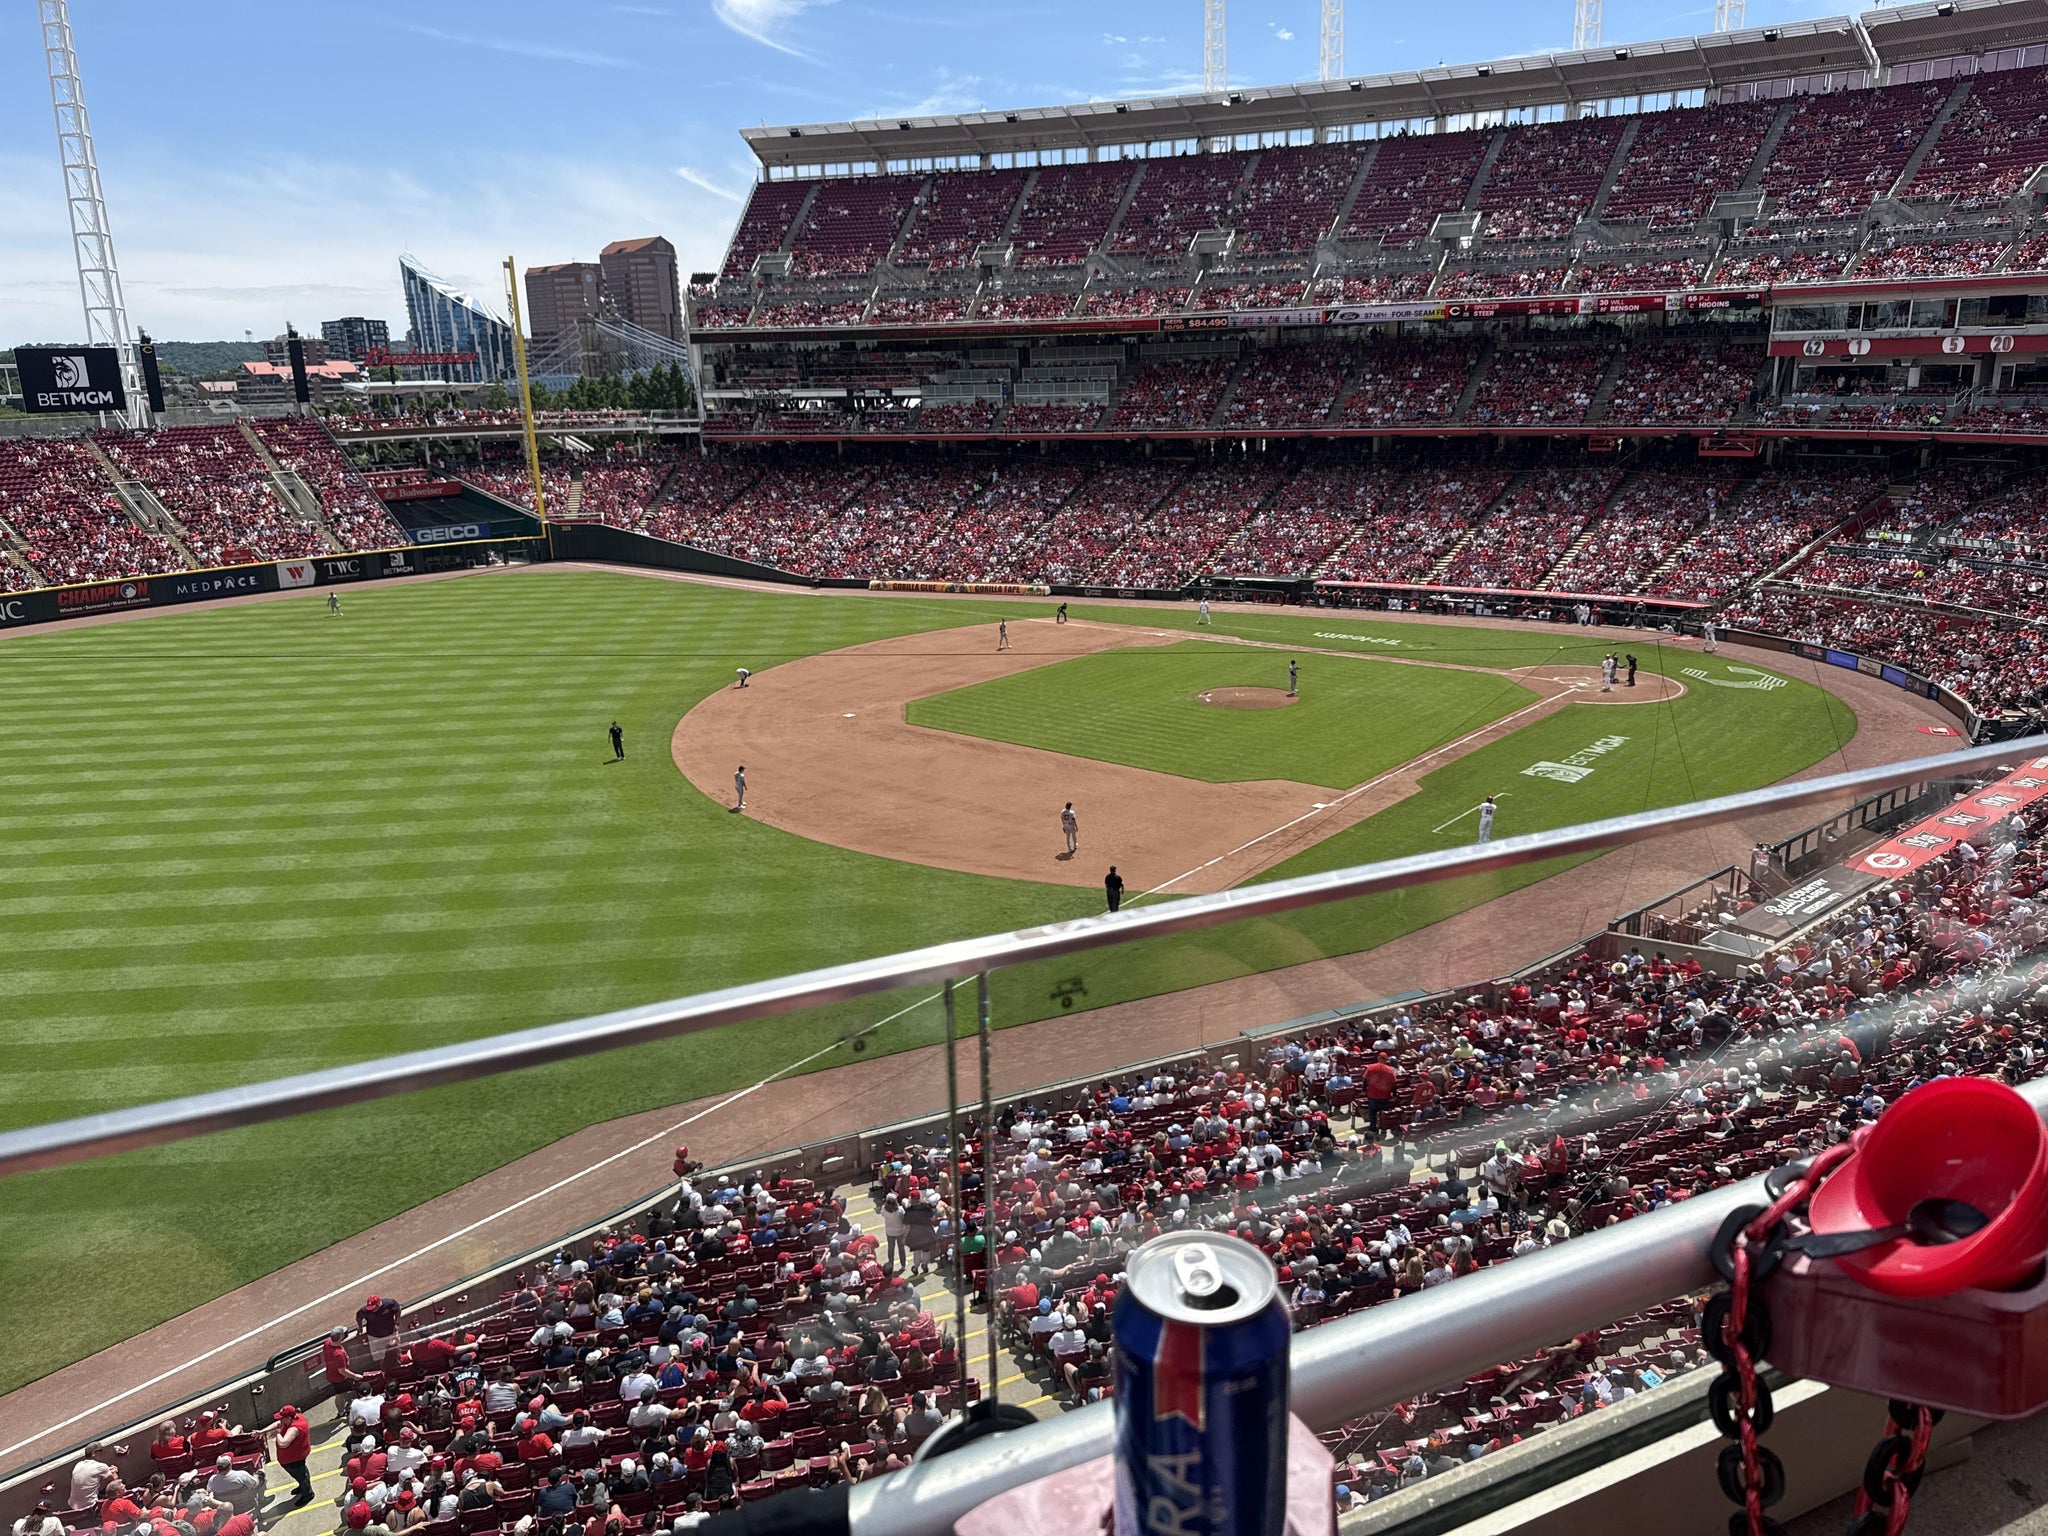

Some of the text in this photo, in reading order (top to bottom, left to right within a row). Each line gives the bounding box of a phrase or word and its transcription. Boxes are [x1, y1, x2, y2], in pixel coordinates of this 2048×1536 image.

[1391, 309, 1435, 318] FOUR-SEAM
[1610, 304, 1640, 312] BENSON
[1188, 317, 1228, 328] $84,490
[1257, 316, 1263, 324] 3
[1284, 315, 1290, 323] 4
[1804, 341, 1821, 354] 42
[1855, 340, 1862, 354] 1
[1949, 338, 1958, 352] 5
[1993, 337, 2011, 351] 20
[37, 390, 114, 407] BETMGM
[751, 388, 792, 399] handlebar
[398, 486, 443, 498] Budweiser
[416, 525, 480, 542] GEICO
[323, 559, 361, 576] TWC
[383, 565, 414, 576] BETMGM
[176, 576, 258, 595] MEDPACE
[892, 583, 937, 593] GORILLA GLUE
[974, 584, 1021, 594] GORILLA TAPE
[1561, 734, 1631, 766] BETMGM
